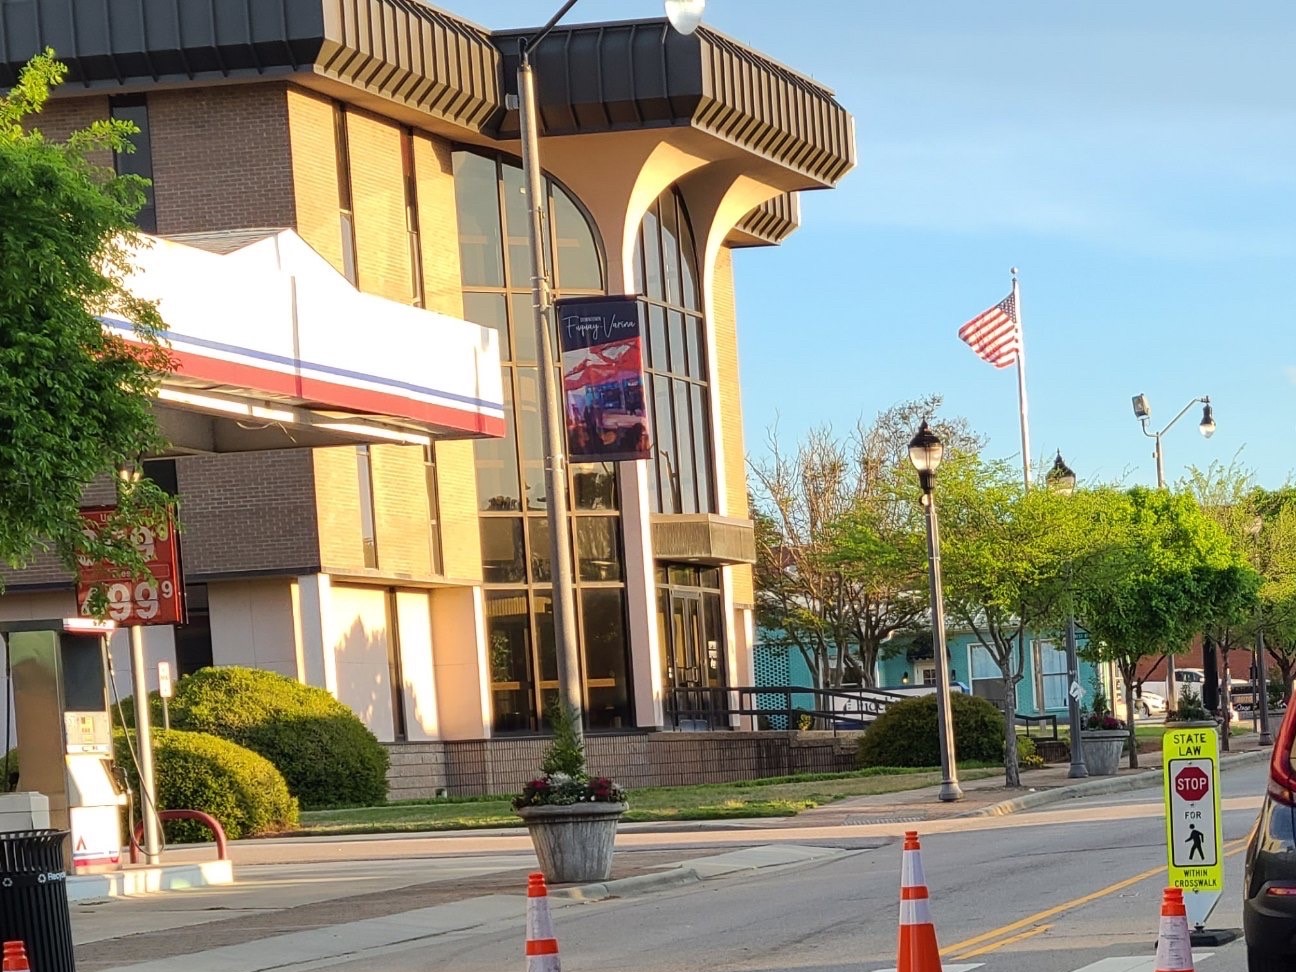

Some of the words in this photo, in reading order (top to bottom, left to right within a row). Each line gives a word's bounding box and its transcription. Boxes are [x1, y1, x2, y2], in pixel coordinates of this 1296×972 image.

[562, 313, 636, 340] Fuquay-Varina
[1173, 733, 1207, 744] STATE
[1178, 746, 1202, 756] LAW
[1177, 778, 1207, 791] STOP
[1184, 811, 1202, 819] FOR
[1183, 869, 1208, 877] WITHIN
[1174, 879, 1217, 888] CROSSWALK
